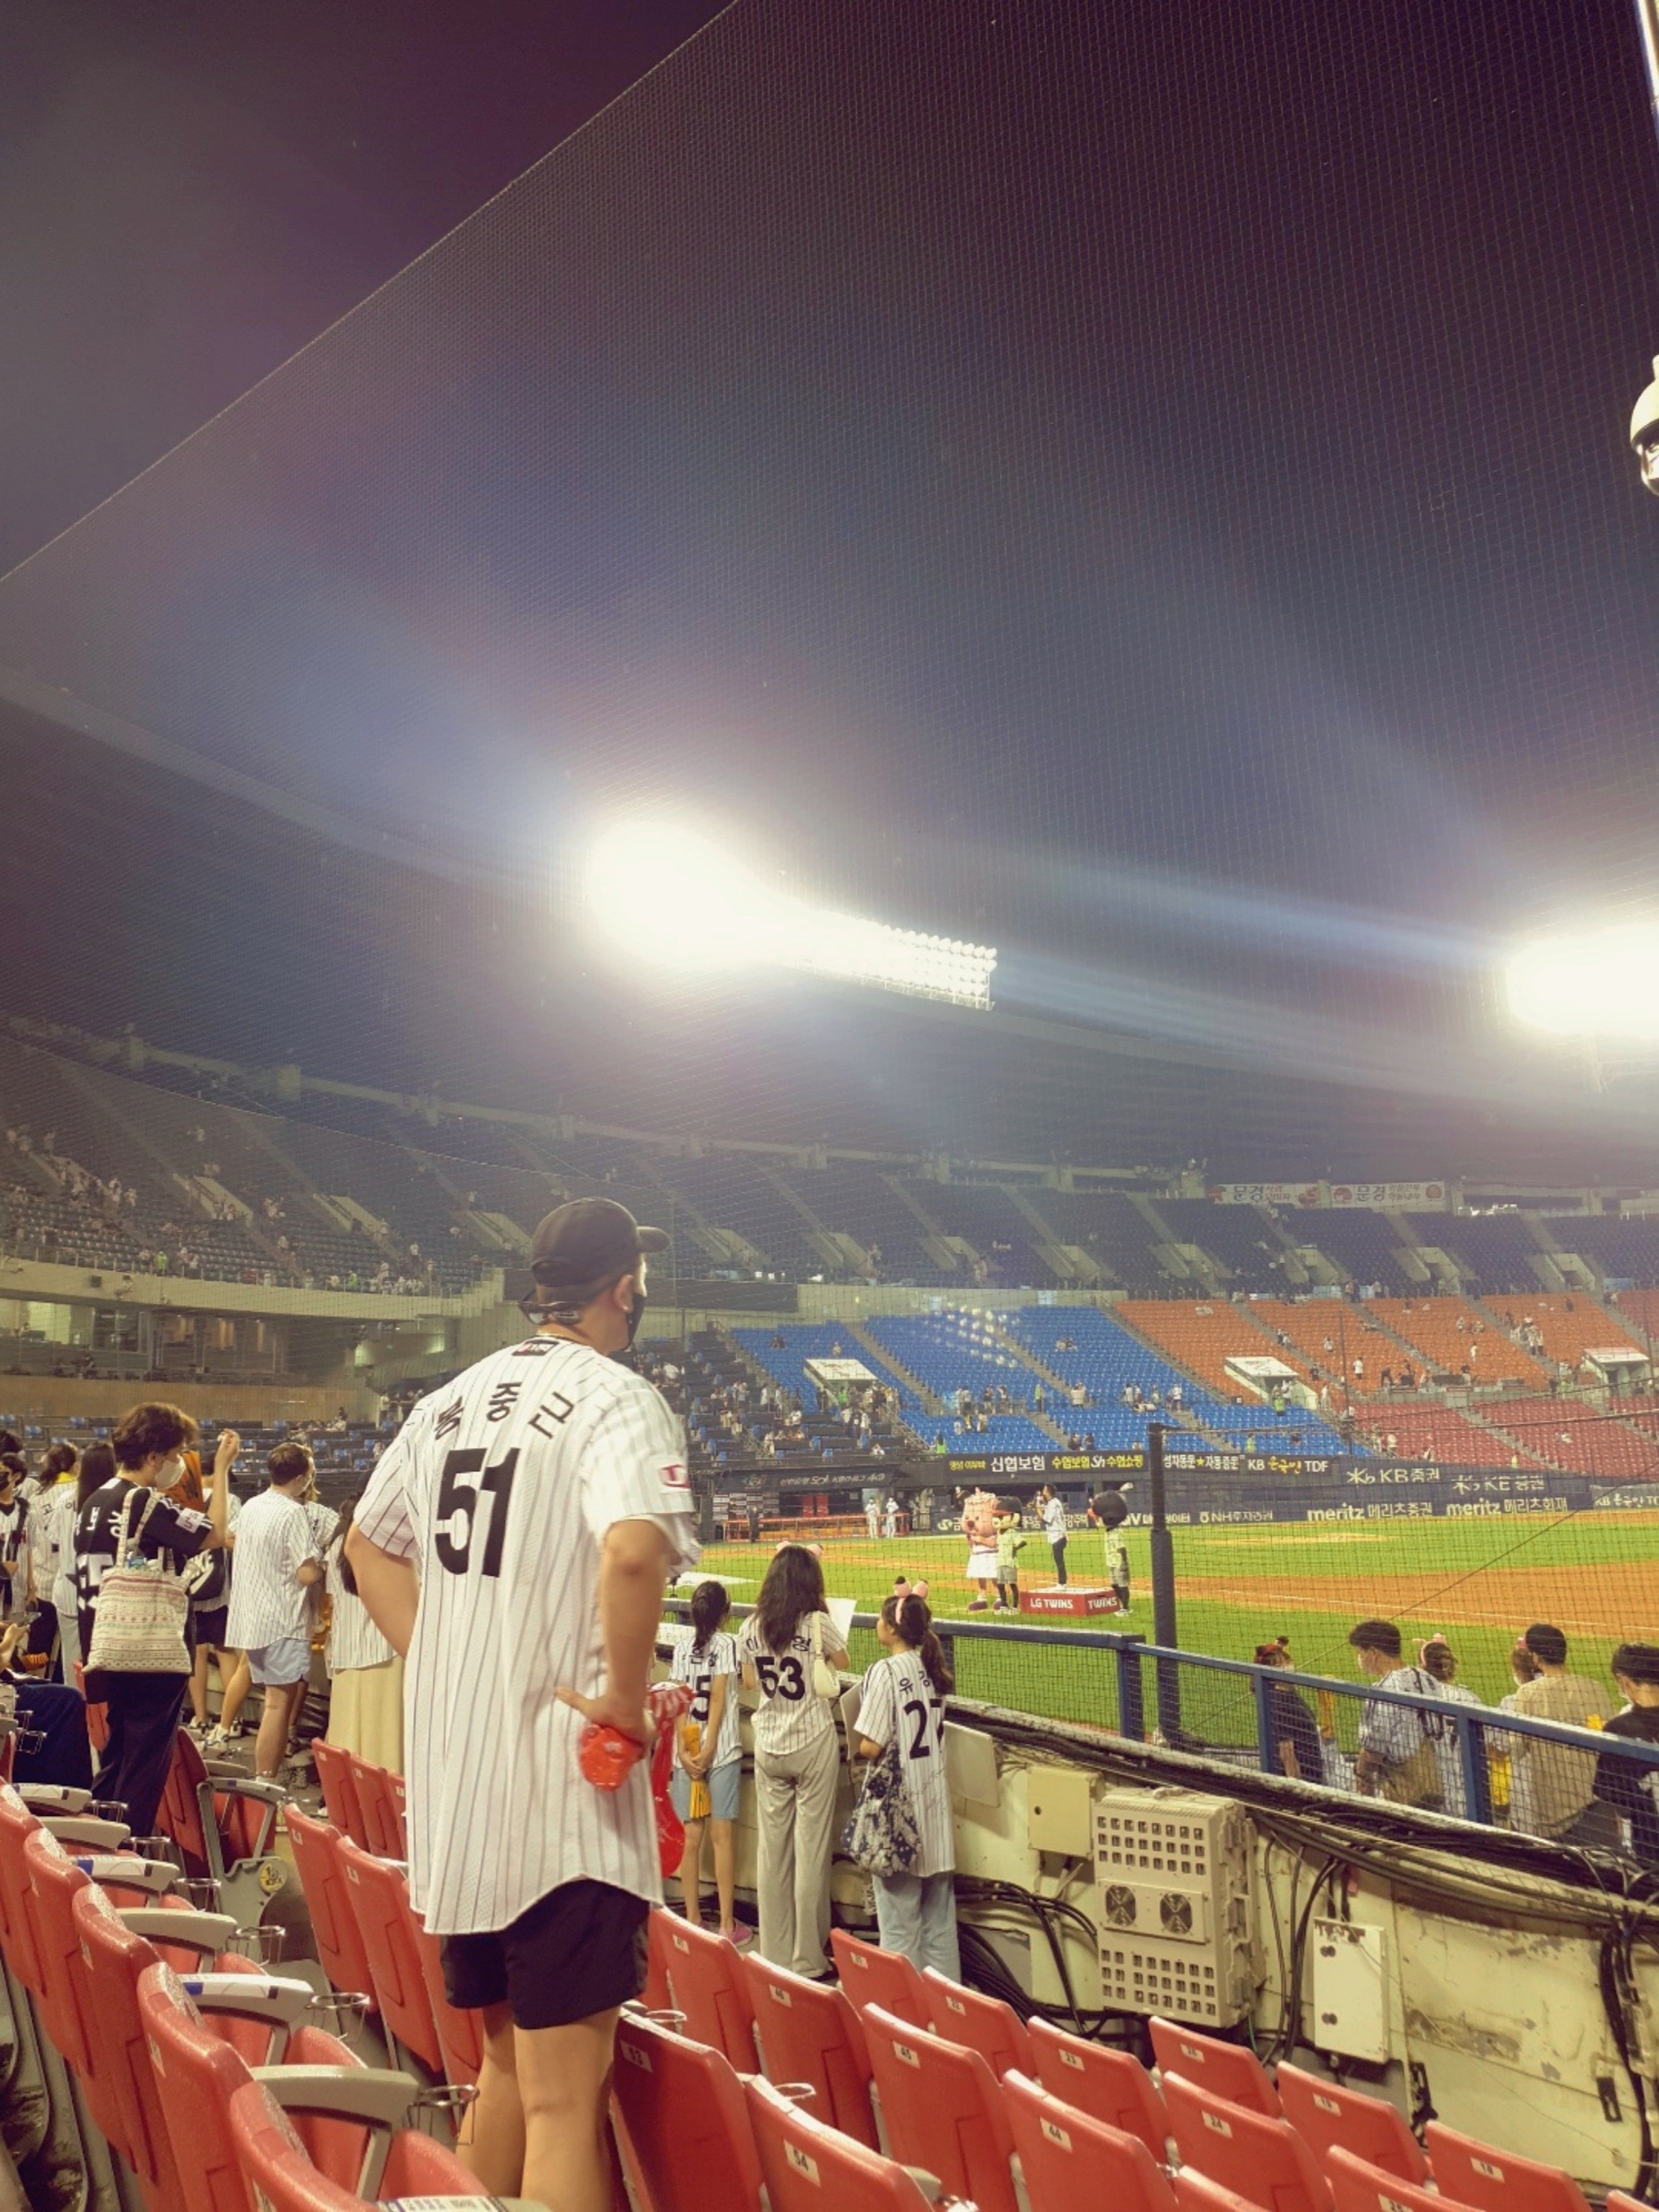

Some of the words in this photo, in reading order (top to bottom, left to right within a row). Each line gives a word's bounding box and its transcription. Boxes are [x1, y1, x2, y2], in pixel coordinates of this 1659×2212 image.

[991, 1454, 1045, 1473] 신협보험
[1248, 1459, 1265, 1471] KB
[1304, 1460, 1329, 1473] TDF
[434, 1447, 521, 1578] 51
[1307, 1502, 1365, 1522] meritz
[1446, 1497, 1501, 1517] meritz
[1030, 1598, 1042, 1608] LG
[1042, 1598, 1074, 1609] TWINS
[1087, 1596, 1118, 1610] TWINS
[755, 1656, 806, 1701] 53
[687, 1674, 712, 1721] 5
[1048, 2125, 1063, 2141] 44
[792, 2148, 809, 2172] 54
